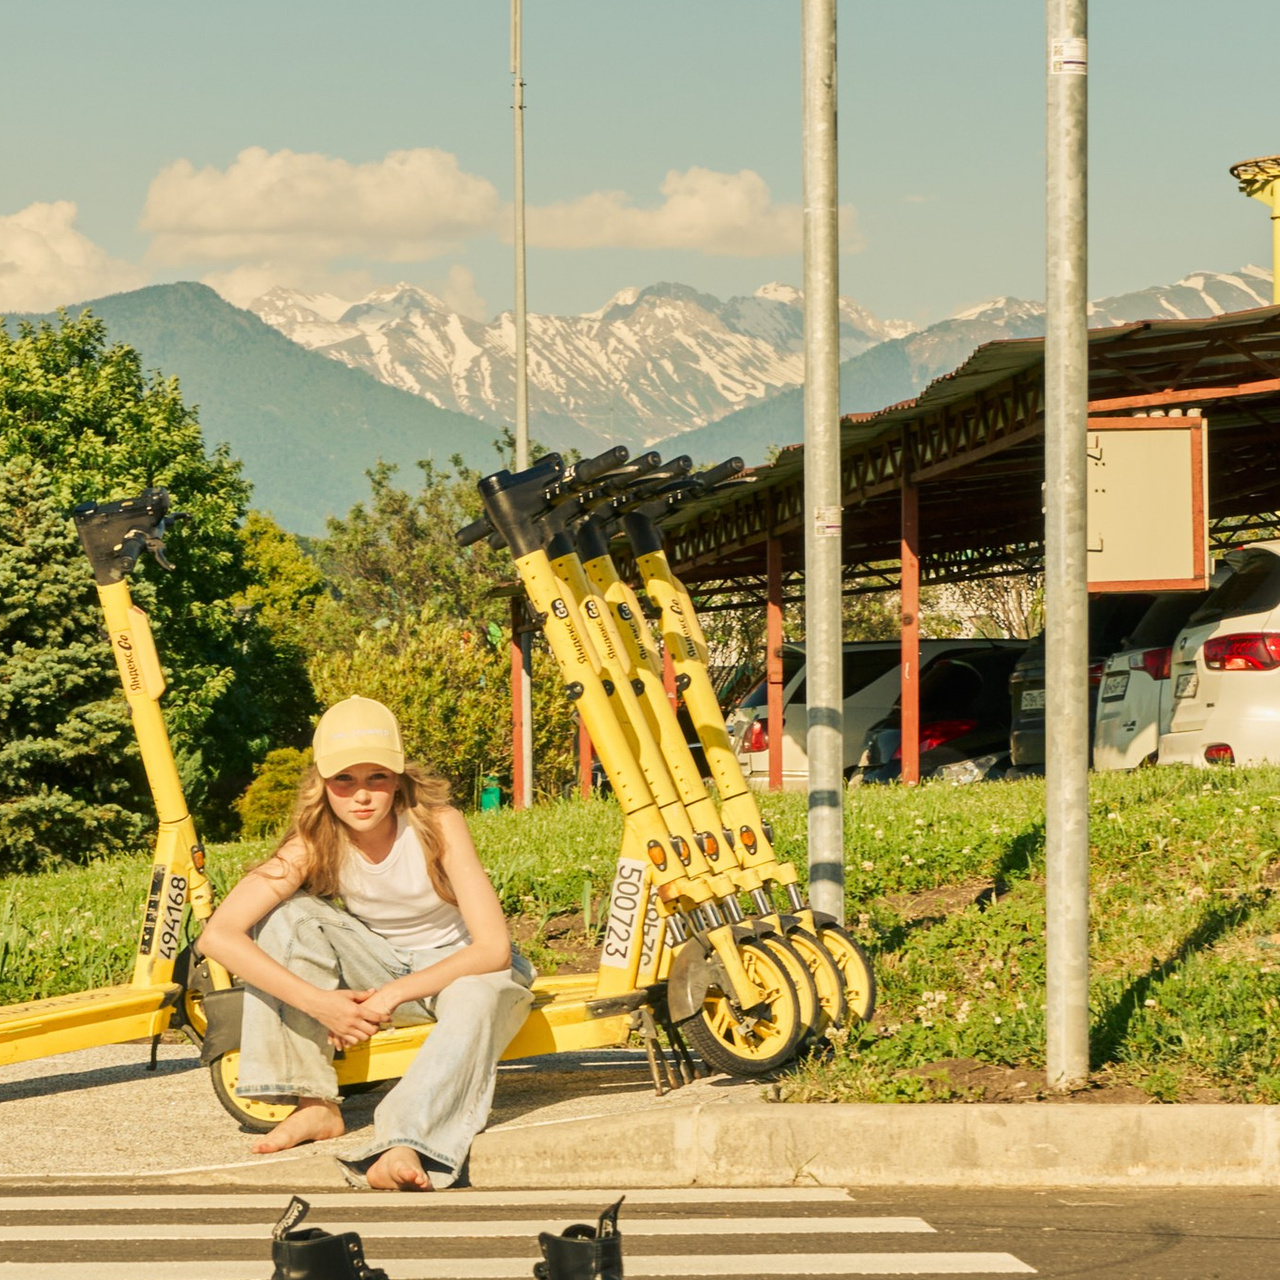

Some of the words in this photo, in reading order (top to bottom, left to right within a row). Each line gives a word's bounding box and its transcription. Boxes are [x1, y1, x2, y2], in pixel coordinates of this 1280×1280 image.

[117, 634, 132, 651] Go
[565, 621, 588, 664] Яндекс
[124, 651, 142, 691] Яндекс
[159, 876, 187, 960] 494168
[604, 864, 643, 959] 500723
